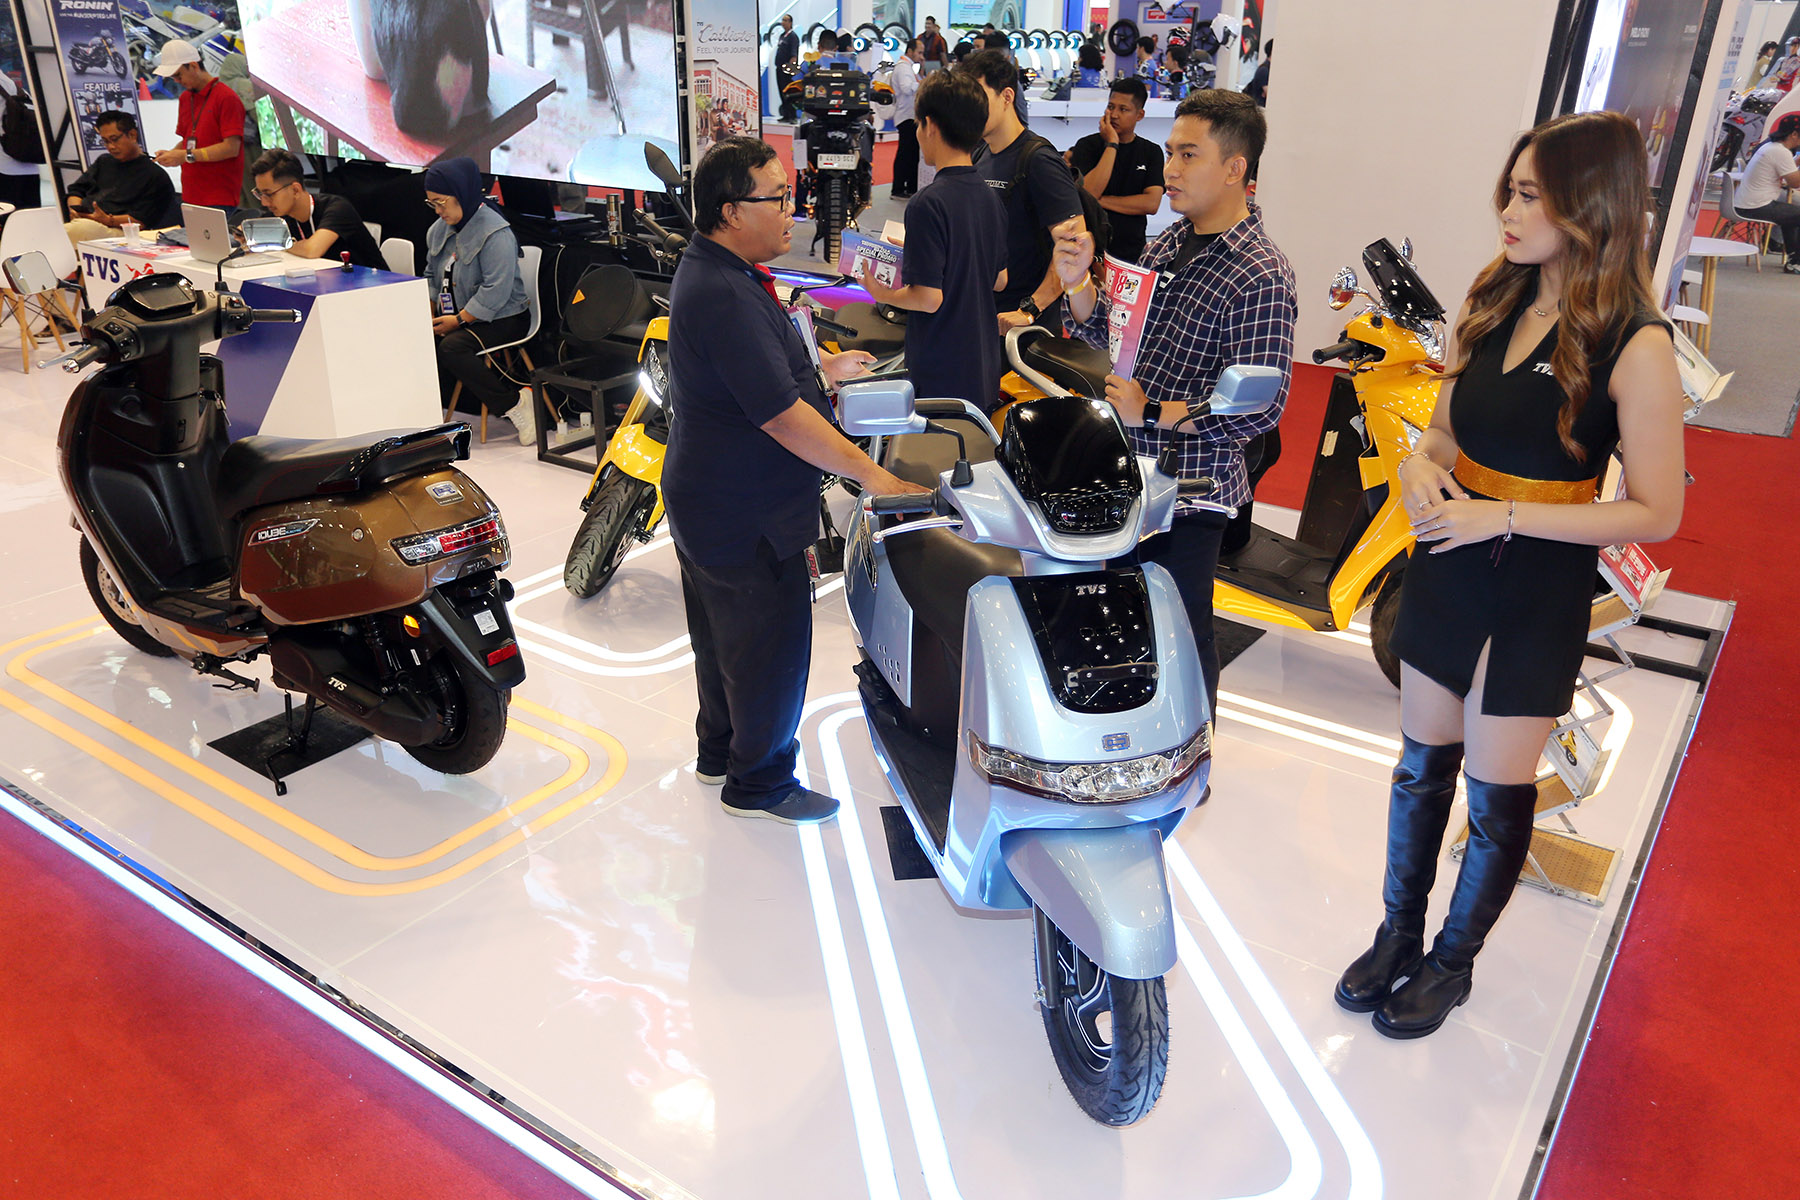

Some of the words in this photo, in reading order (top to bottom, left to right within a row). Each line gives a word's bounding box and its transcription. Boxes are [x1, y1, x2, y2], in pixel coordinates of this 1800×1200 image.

[58, 0, 114, 11] RONIN
[696, 46, 712, 54] FEEL
[712, 46, 729, 54] YOUR
[84, 83, 121, 93] FEATURE
[82, 252, 120, 284] TVS
[1075, 583, 1107, 596] TVS
[328, 676, 348, 691] TVS
